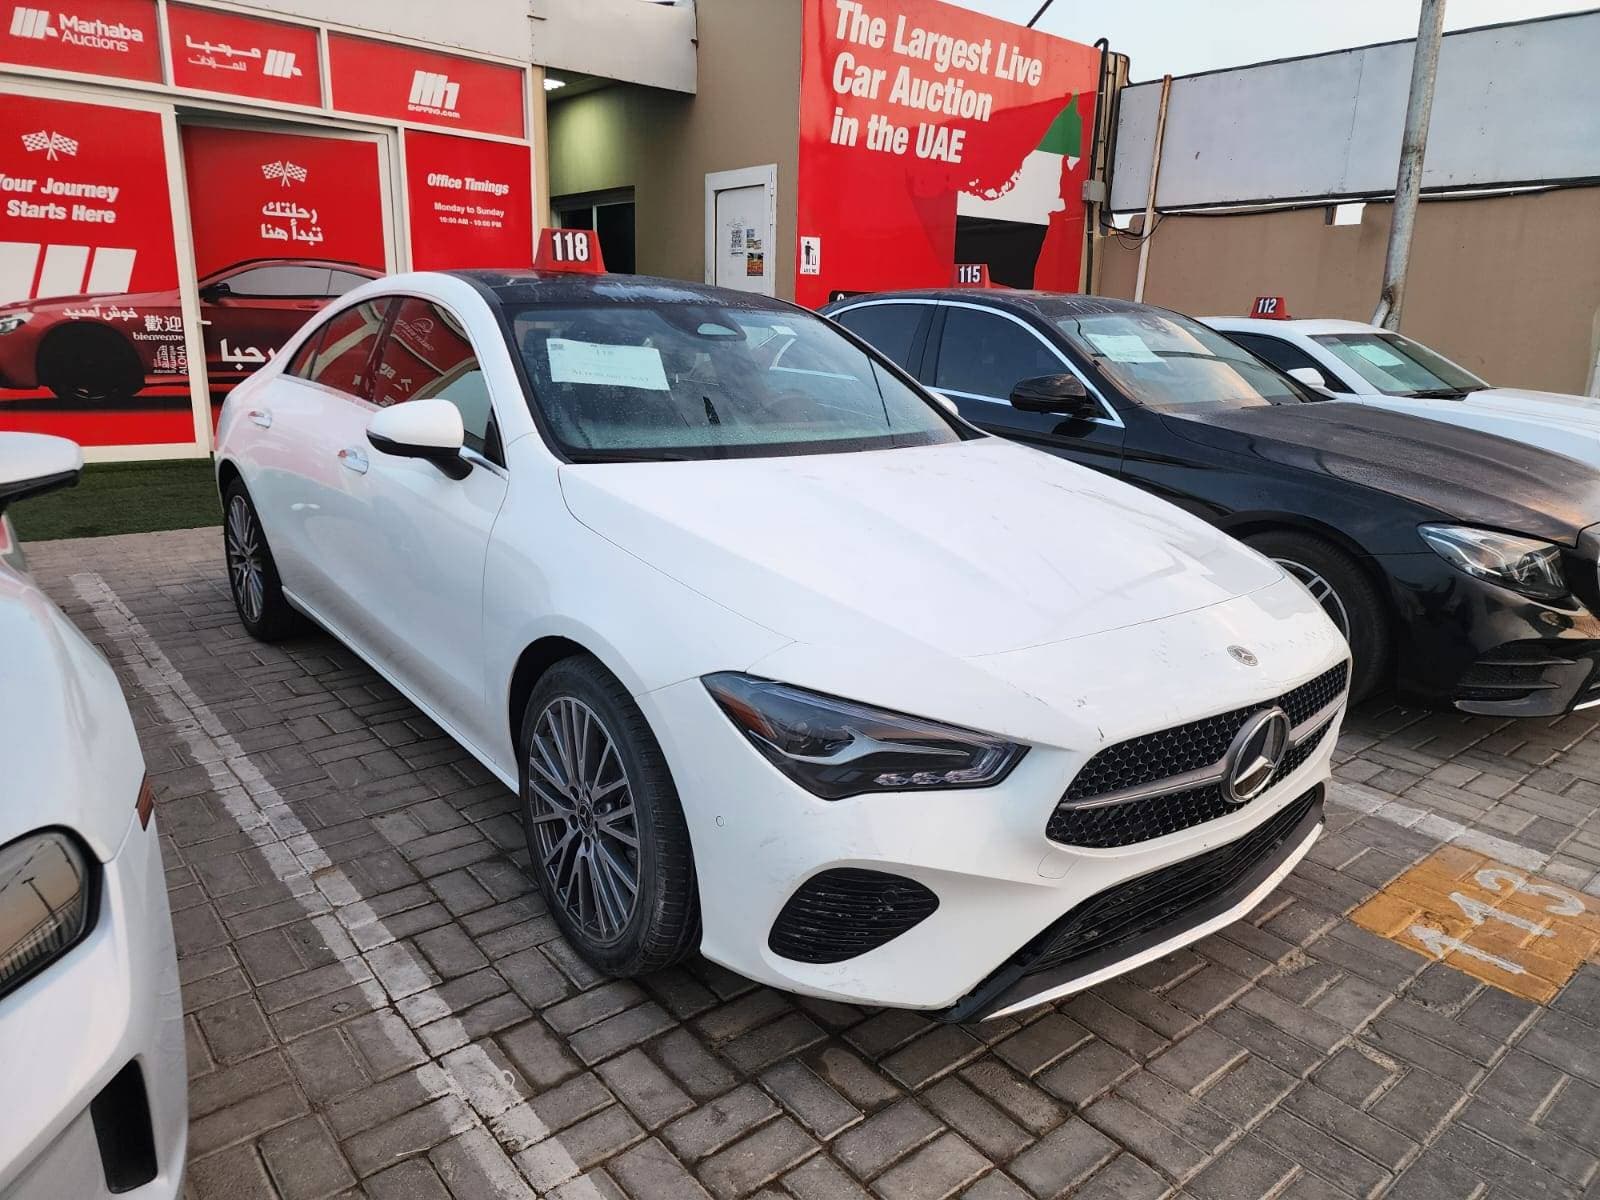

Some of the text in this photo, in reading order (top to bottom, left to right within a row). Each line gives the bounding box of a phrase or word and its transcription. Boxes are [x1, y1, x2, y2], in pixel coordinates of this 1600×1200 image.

[58, 12, 144, 42] Marhaba
[61, 29, 129, 53] Auctions
[835, 0, 1044, 87] The Largest Live
[832, 52, 993, 122] Car Auction
[830, 107, 967, 164] in the UAE
[40, 177, 119, 203] Journey
[427, 173, 510, 197] Office Timings
[6, 199, 117, 224] Starts Here
[262, 201, 318, 225] رحلتك
[434, 202, 504, 218] Monday to Sunday
[260, 217, 324, 246] تبدأ هنا
[552, 231, 589, 262] 118
[959, 264, 981, 283] 115
[102, 304, 139, 322] خوش
[1257, 297, 1277, 314] 112
[144, 314, 183, 332] 歡迎
[132, 331, 184, 341] bienvenue
[176, 345, 188, 375] ALOHA
[1408, 868, 1586, 975] 113
